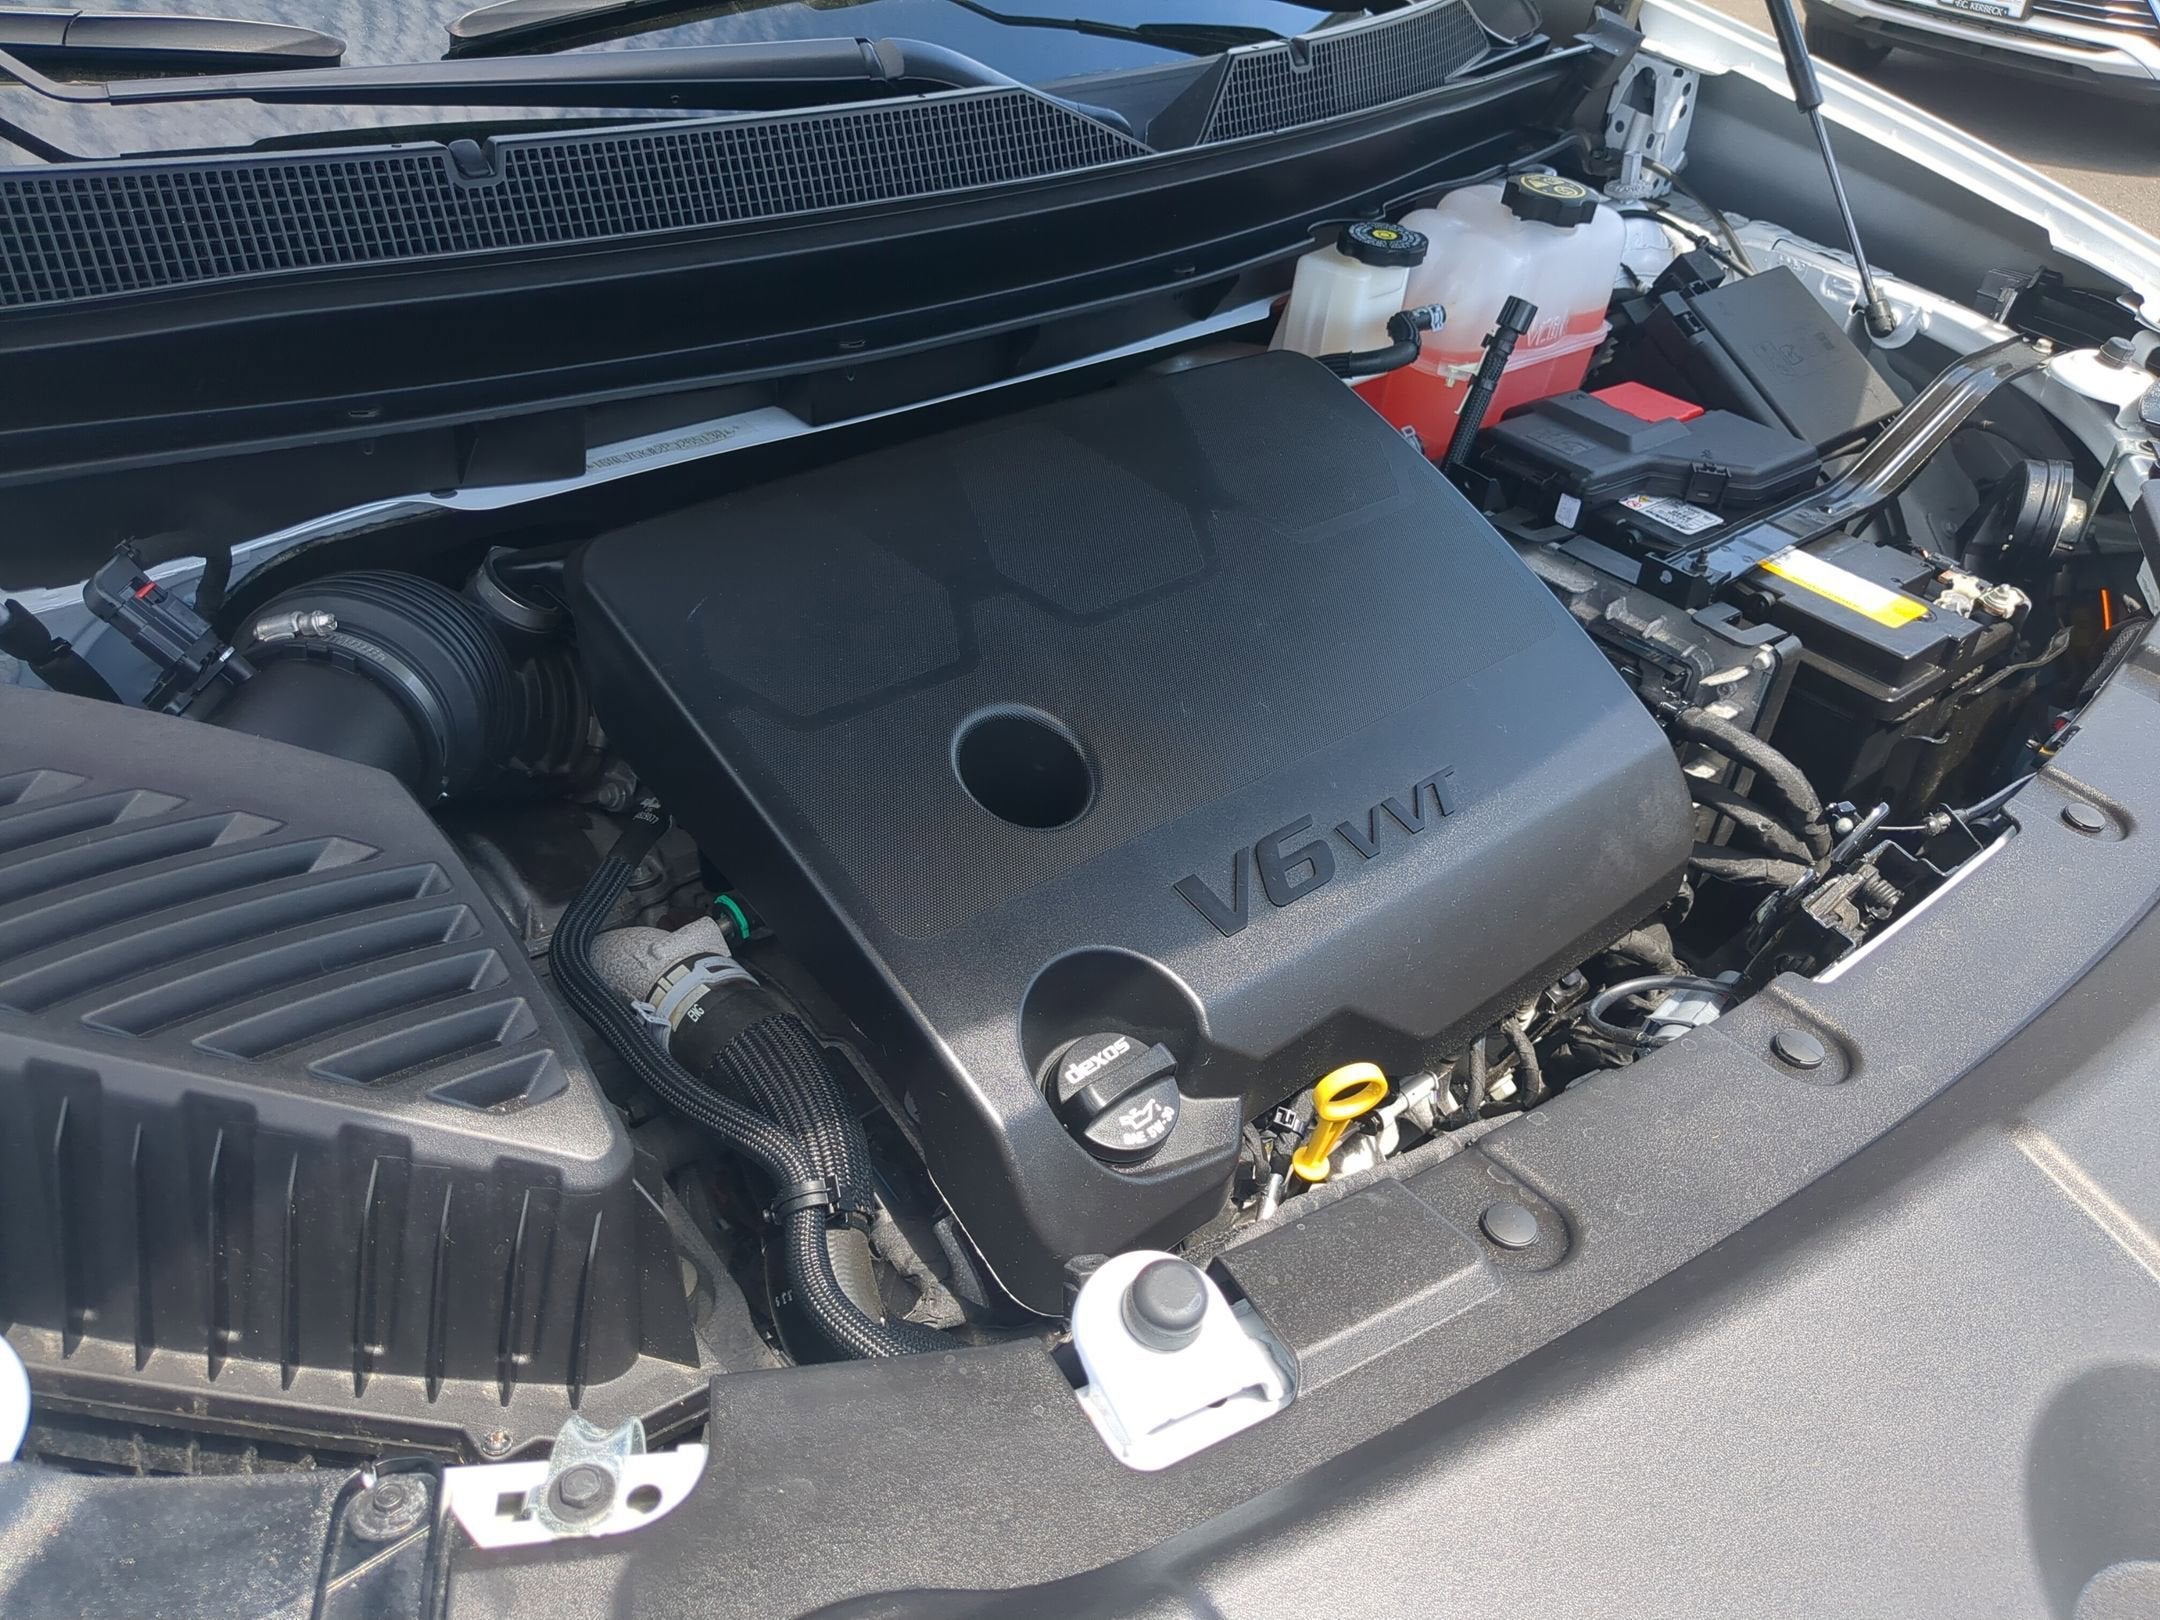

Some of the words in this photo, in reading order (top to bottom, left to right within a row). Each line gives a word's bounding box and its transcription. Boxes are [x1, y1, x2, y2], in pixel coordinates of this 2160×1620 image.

[1173, 813, 1336, 938] V6
[1335, 764, 1457, 859] VVT
[687, 1003, 705, 1022] ENG
[1064, 1036, 1131, 1084] dexos
[1146, 1106, 1175, 1138] 5W-30
